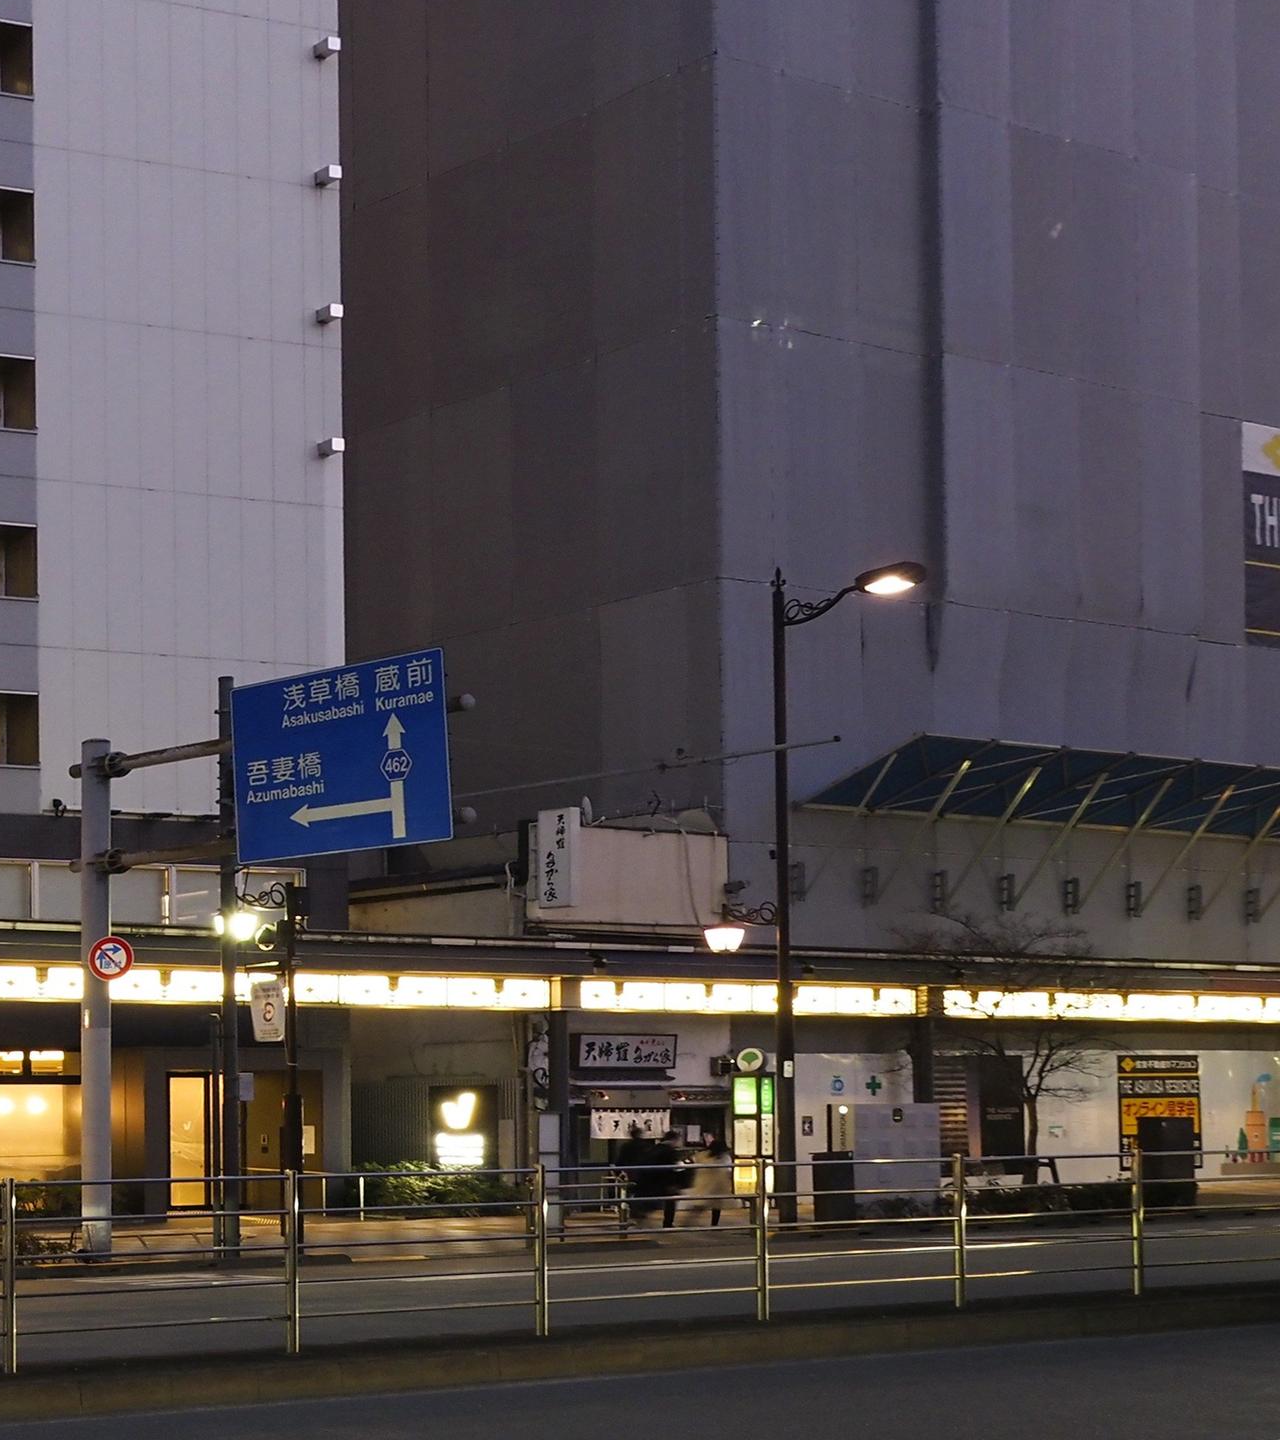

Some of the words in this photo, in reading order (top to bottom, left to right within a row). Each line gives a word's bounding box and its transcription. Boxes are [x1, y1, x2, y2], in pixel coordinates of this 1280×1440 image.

[1251, 494, 1280, 548] TH
[283, 672, 360, 711] 浅草橋
[375, 658, 433, 693] 蔵前
[282, 700, 364, 728] Asakusabashi
[376, 691, 434, 711] Kuramae
[247, 752, 322, 786] 吾妻橋
[385, 757, 407, 774] 462
[247, 780, 324, 804] Azumabashi
